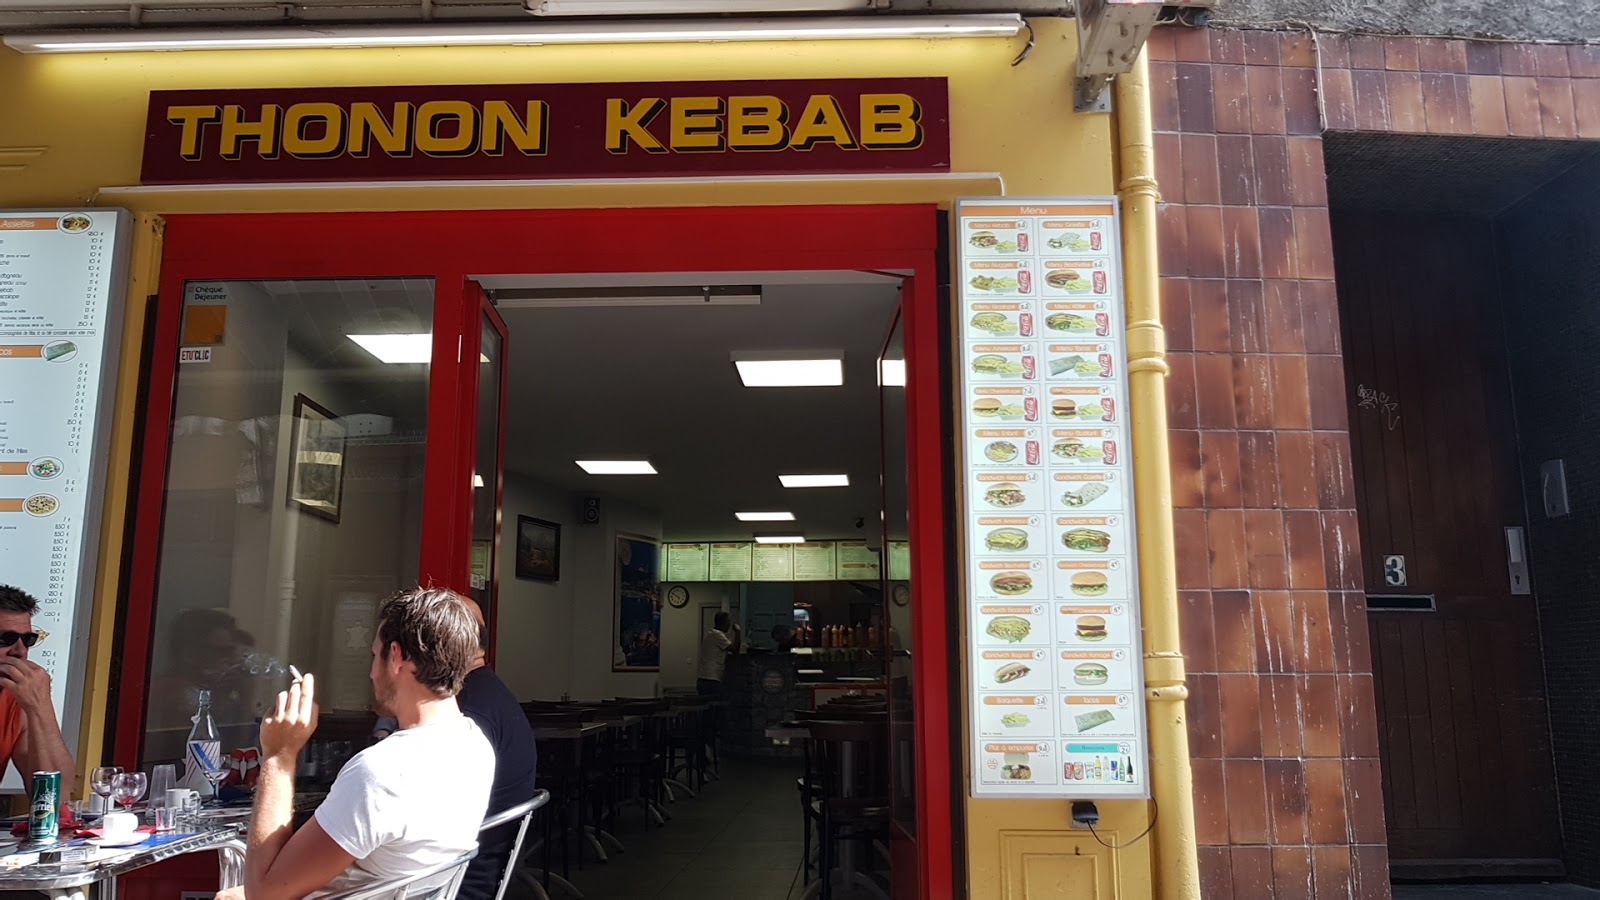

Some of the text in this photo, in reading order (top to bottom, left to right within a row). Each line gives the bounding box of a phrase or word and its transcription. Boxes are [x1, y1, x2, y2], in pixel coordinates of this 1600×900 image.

[166, 93, 924, 162] THONON KEBAB
[1020, 207, 1047, 215] Menu
[1, 219, 35, 228] Assiettes
[1385, 556, 1405, 585] 3
[1083, 696, 1099, 704] Tacos
